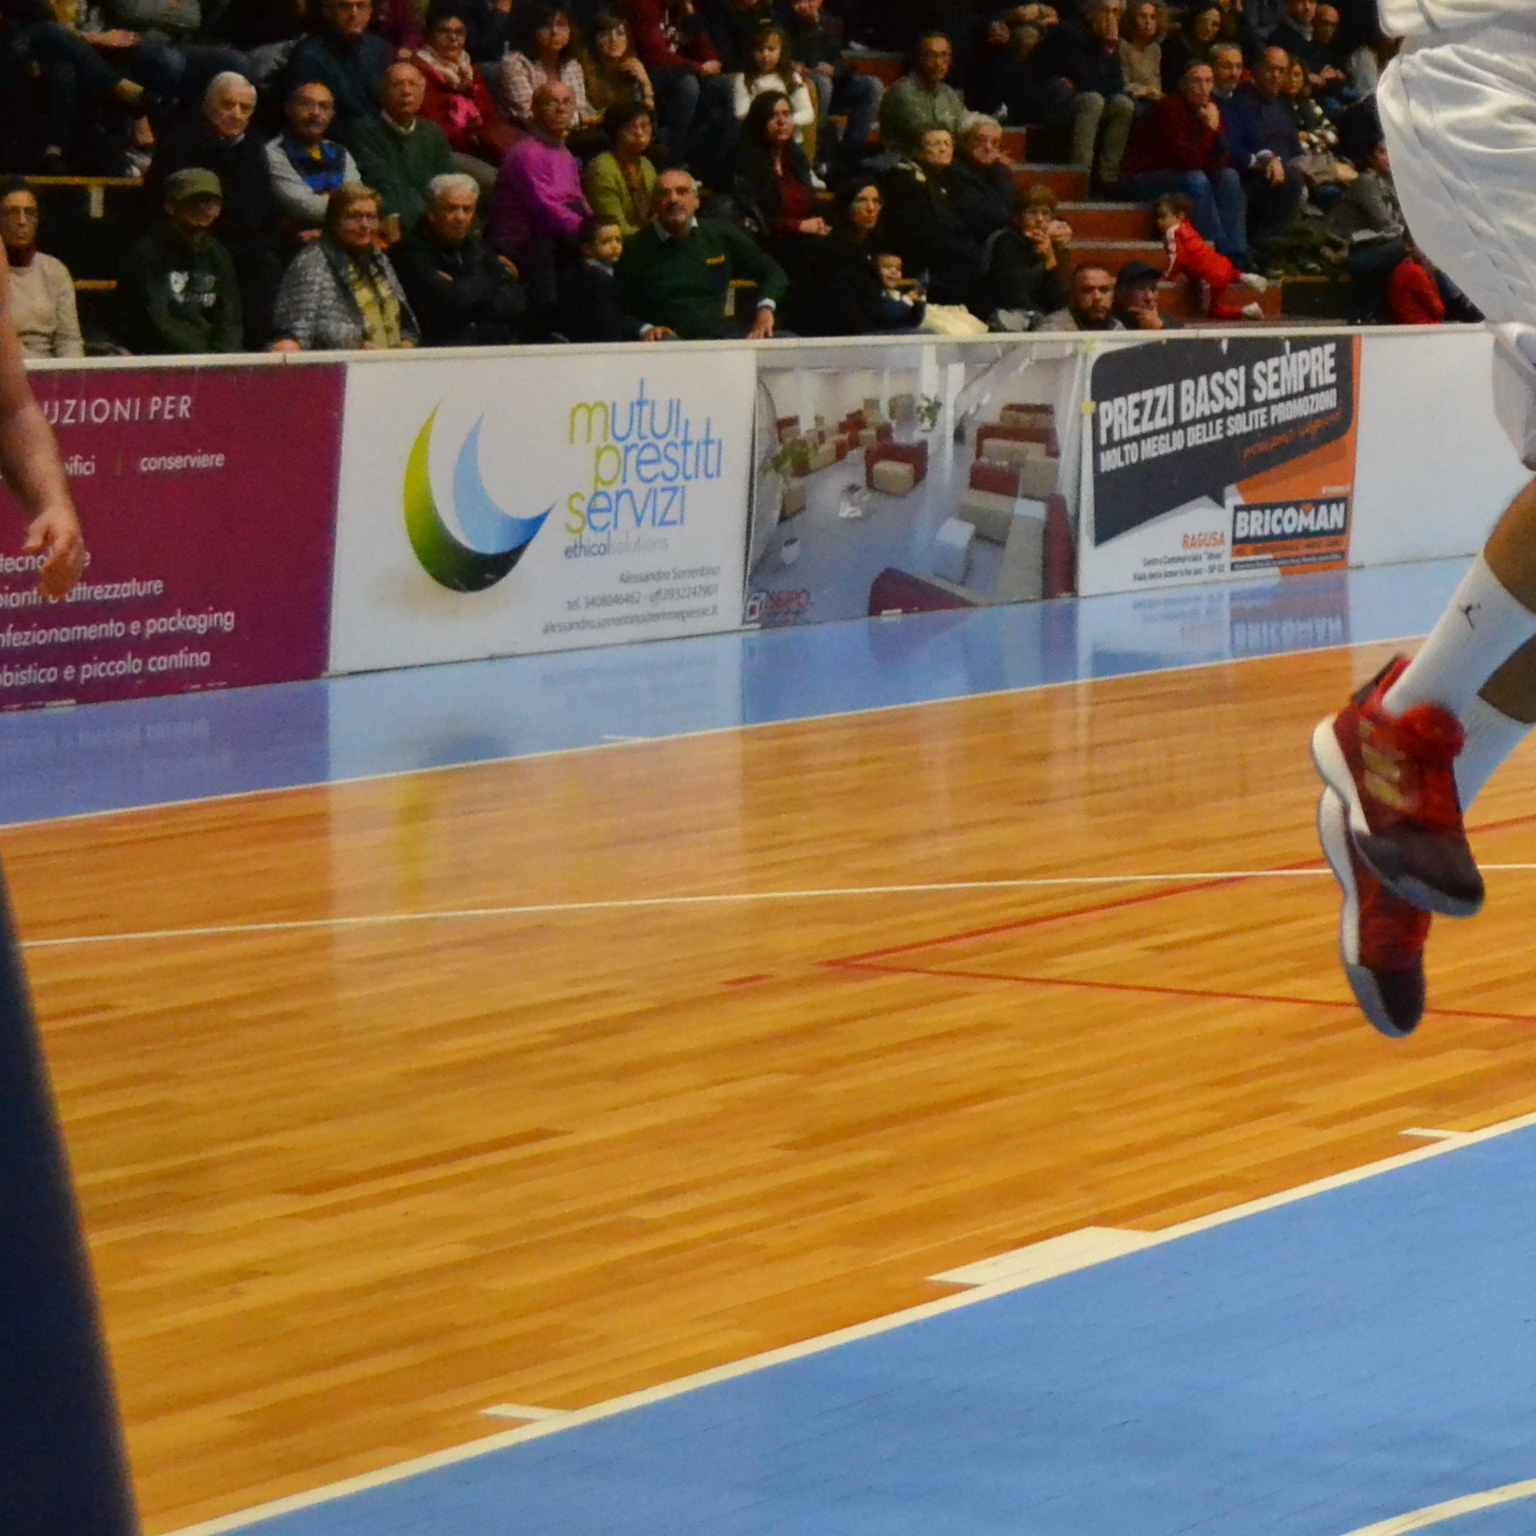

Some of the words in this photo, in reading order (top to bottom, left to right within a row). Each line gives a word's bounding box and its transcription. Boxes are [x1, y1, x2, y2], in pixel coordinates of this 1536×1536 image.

[149, 394, 193, 421] PER
[569, 377, 681, 445] mutui
[1099, 383, 1175, 445] PREZZI
[1180, 365, 1246, 423] BASSI
[1252, 342, 1337, 403] SEMPRE
[1100, 443, 1140, 473] MOLTO
[1140, 432, 1185, 461] MEGLIO
[1186, 420, 1225, 448] DELLE
[1226, 407, 1268, 437] SOLITE
[1270, 388, 1337, 425] PROMOZIONI
[140, 448, 226, 473] conserviere
[594, 416, 723, 508] prestiti
[565, 484, 686, 535] servizi
[1235, 502, 1346, 539] BRICOMAN
[1182, 530, 1226, 550] RAGUSA
[129, 621, 141, 636] e
[145, 607, 236, 639] packaging
[63, 665, 76, 681] e
[80, 650, 142, 684] piccola
[147, 646, 211, 672] cantina
